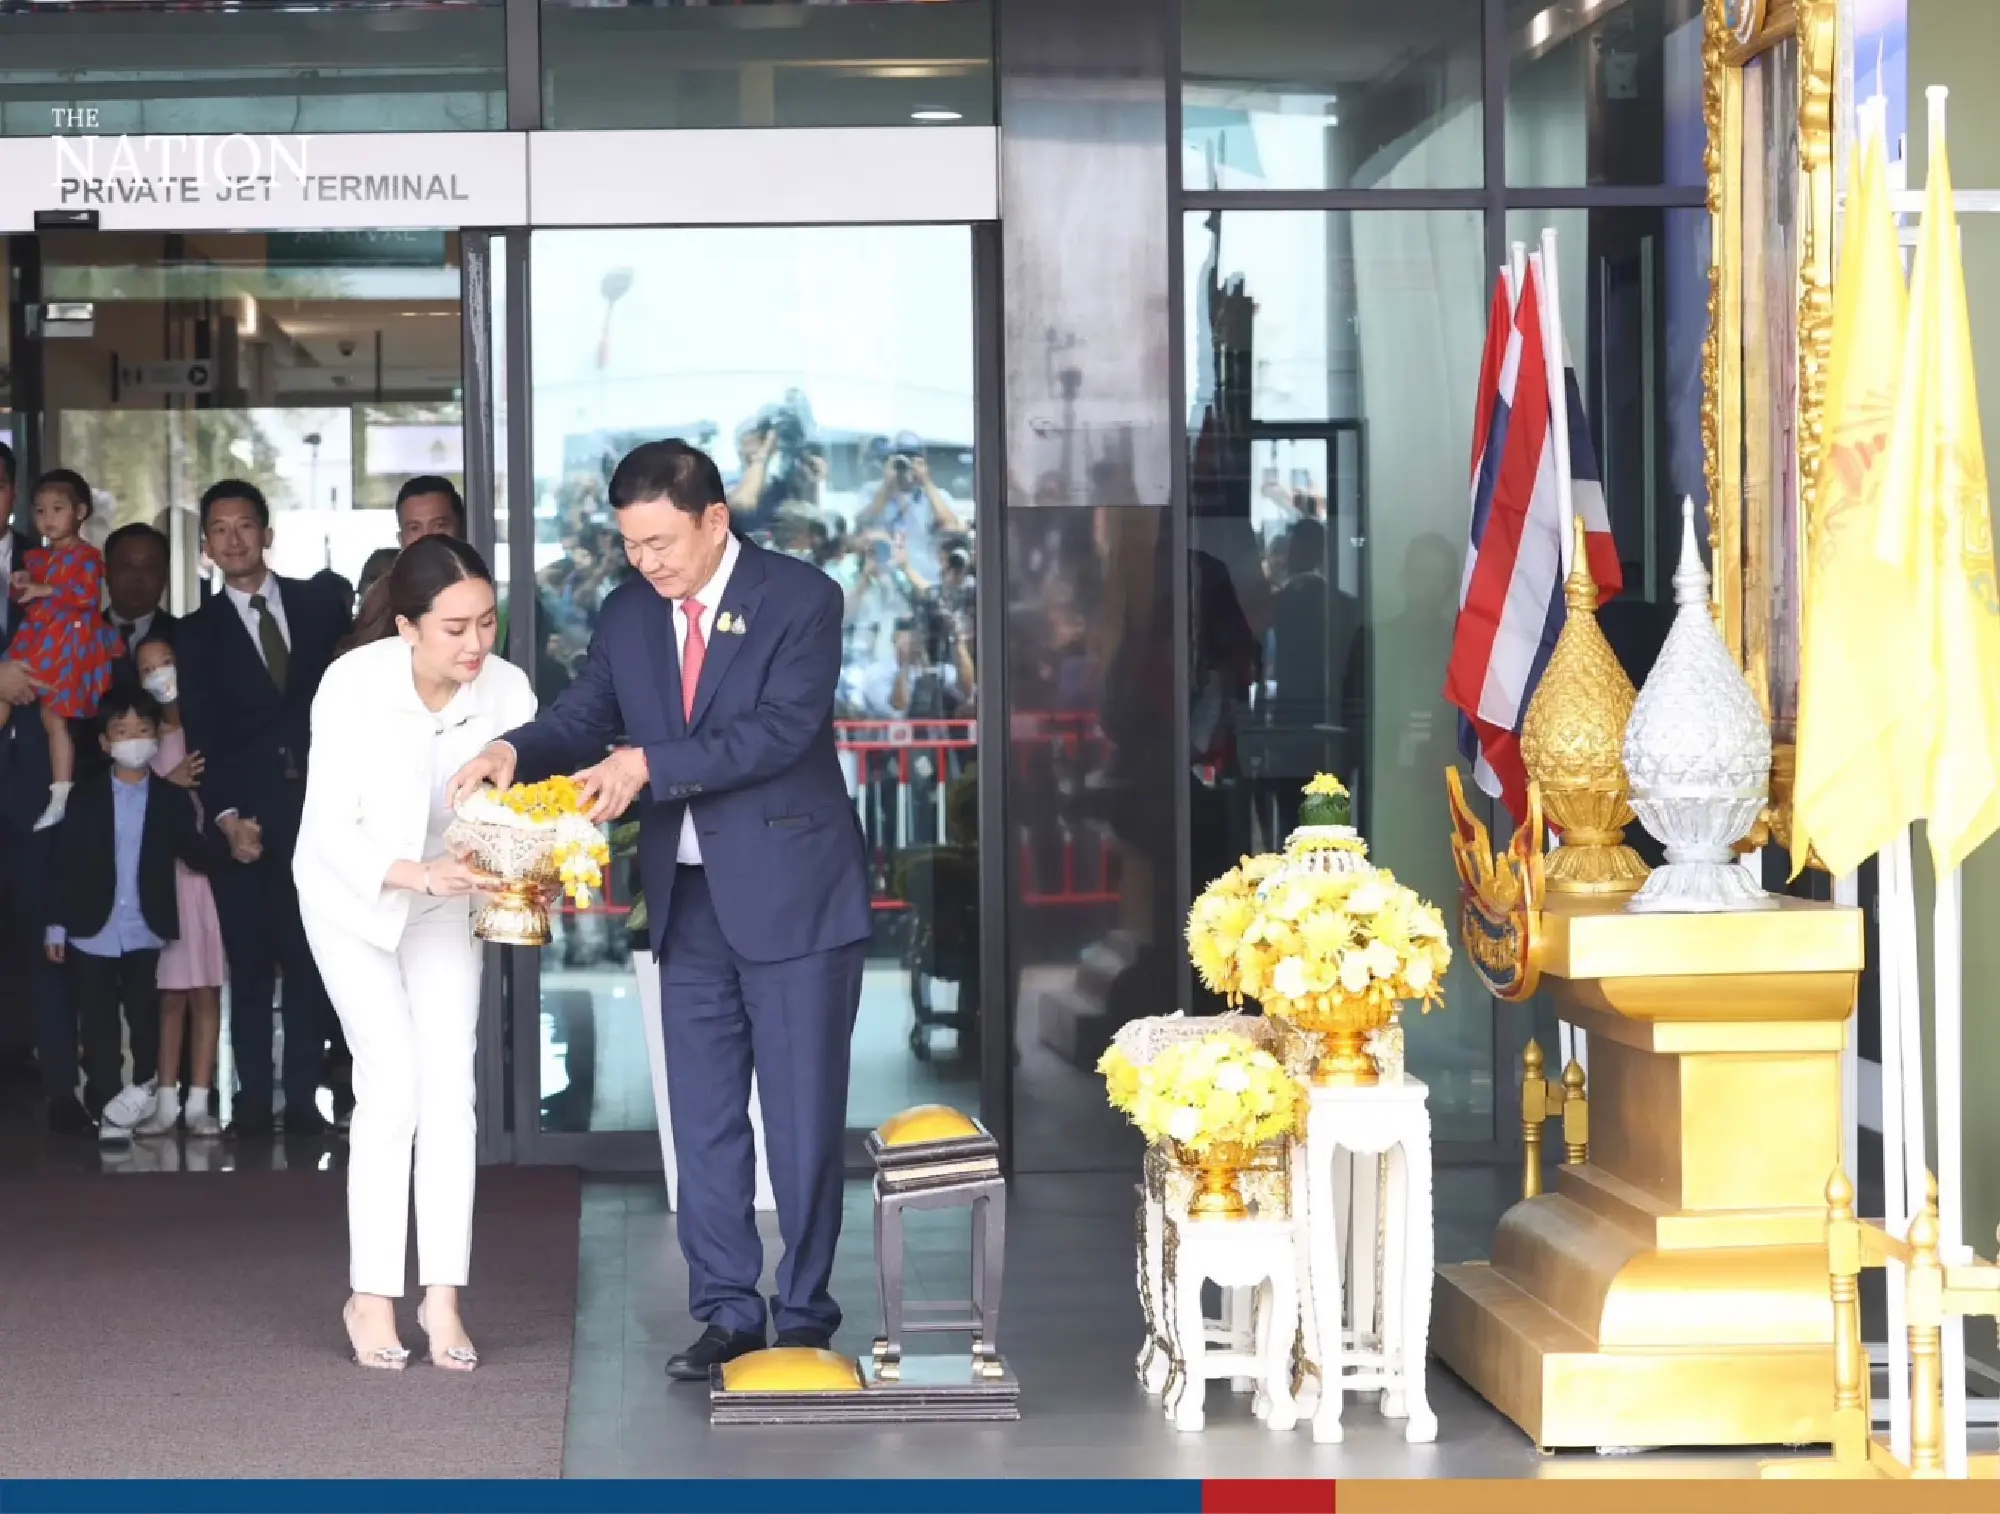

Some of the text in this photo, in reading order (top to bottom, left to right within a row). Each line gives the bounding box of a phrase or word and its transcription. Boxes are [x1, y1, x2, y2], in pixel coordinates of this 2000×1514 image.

[61, 174, 468, 203] PRIVATE JET TERMINAL
